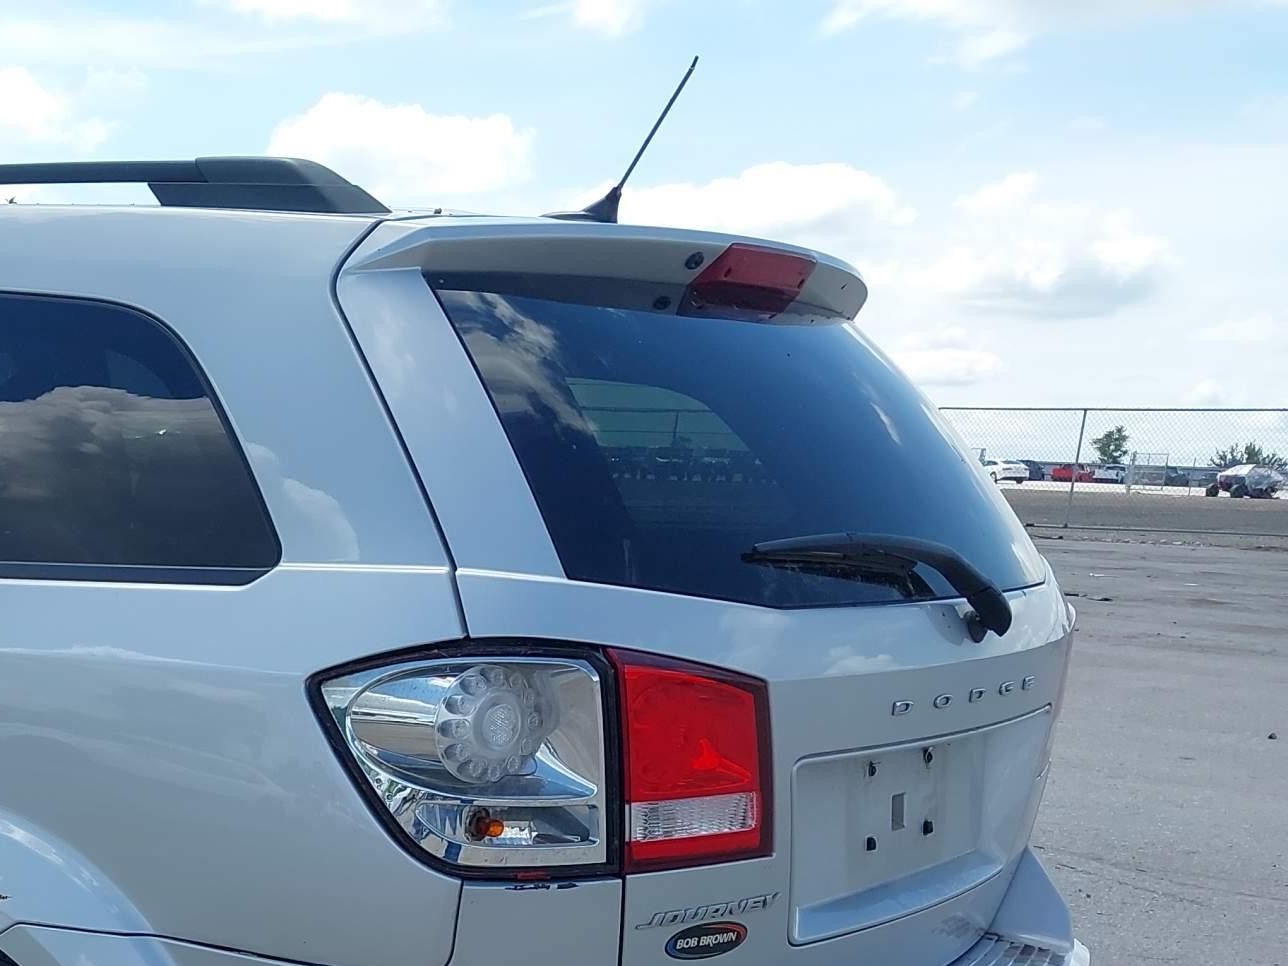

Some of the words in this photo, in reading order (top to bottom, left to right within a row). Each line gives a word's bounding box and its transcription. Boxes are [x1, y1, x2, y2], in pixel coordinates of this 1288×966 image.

[891, 675, 1036, 717] DODGE
[635, 891, 781, 930] JOURNEY
[676, 937, 699, 950] BOB
[699, 931, 737, 947] BROWN
